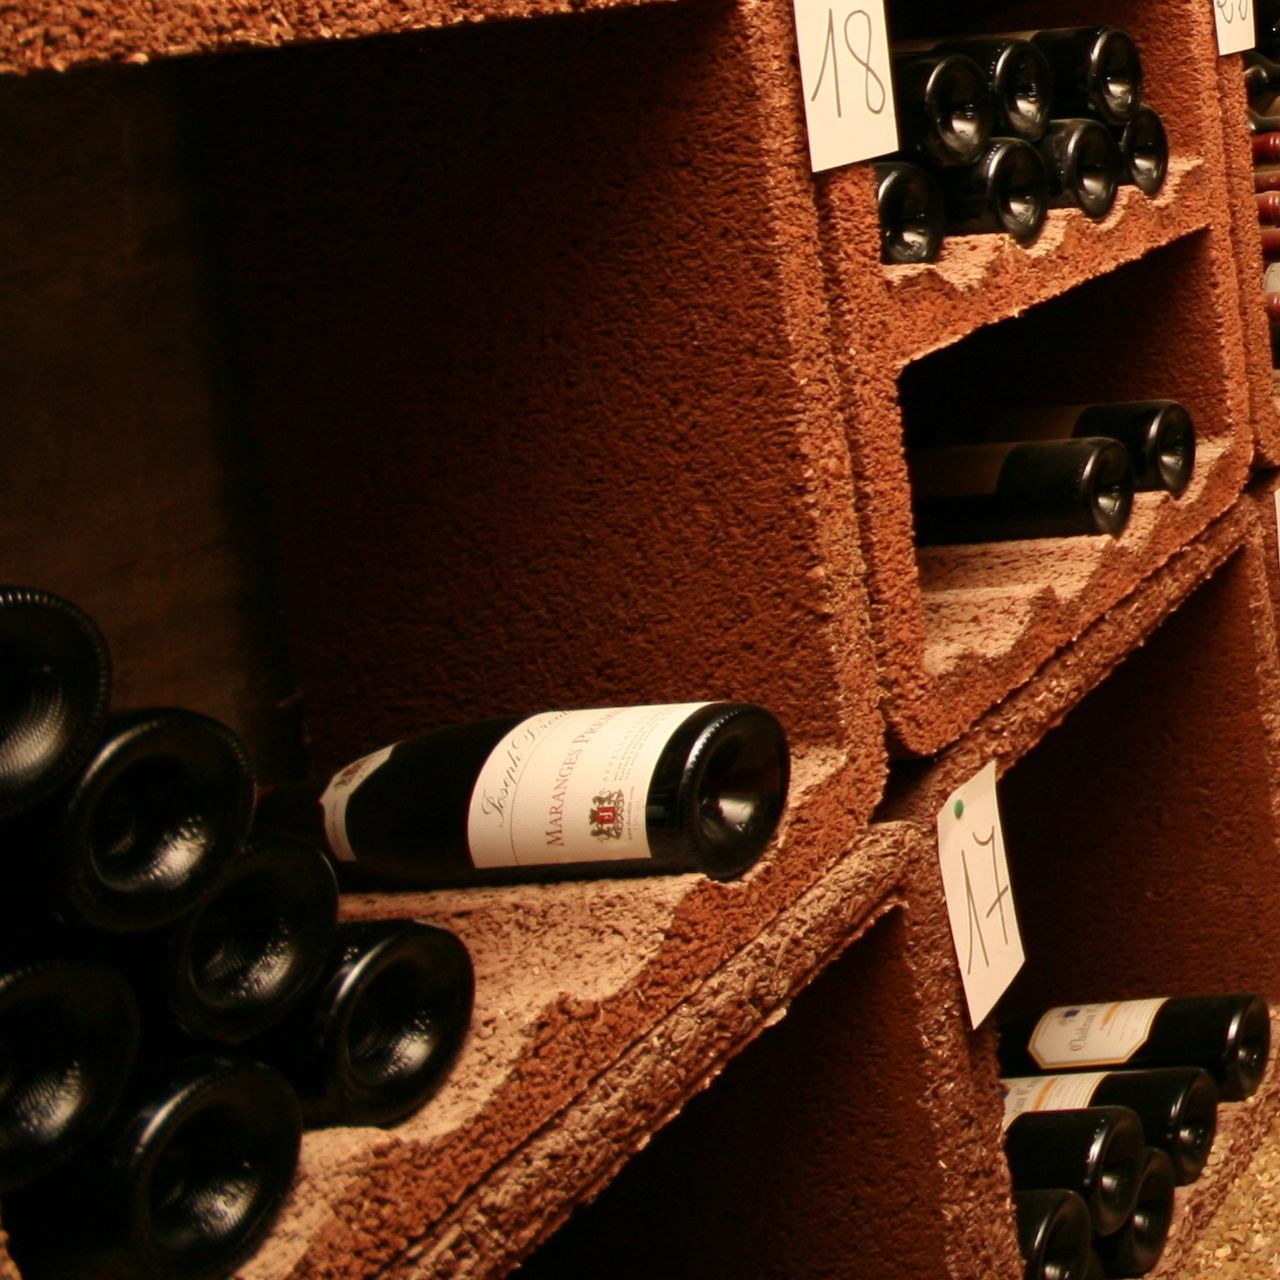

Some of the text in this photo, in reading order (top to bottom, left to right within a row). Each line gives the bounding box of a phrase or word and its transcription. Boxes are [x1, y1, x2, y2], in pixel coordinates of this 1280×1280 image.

[811, 8, 886, 115] 18
[481, 750, 523, 828] Joseph
[545, 748, 583, 848] MARANGES
[961, 825, 1009, 976] 17
